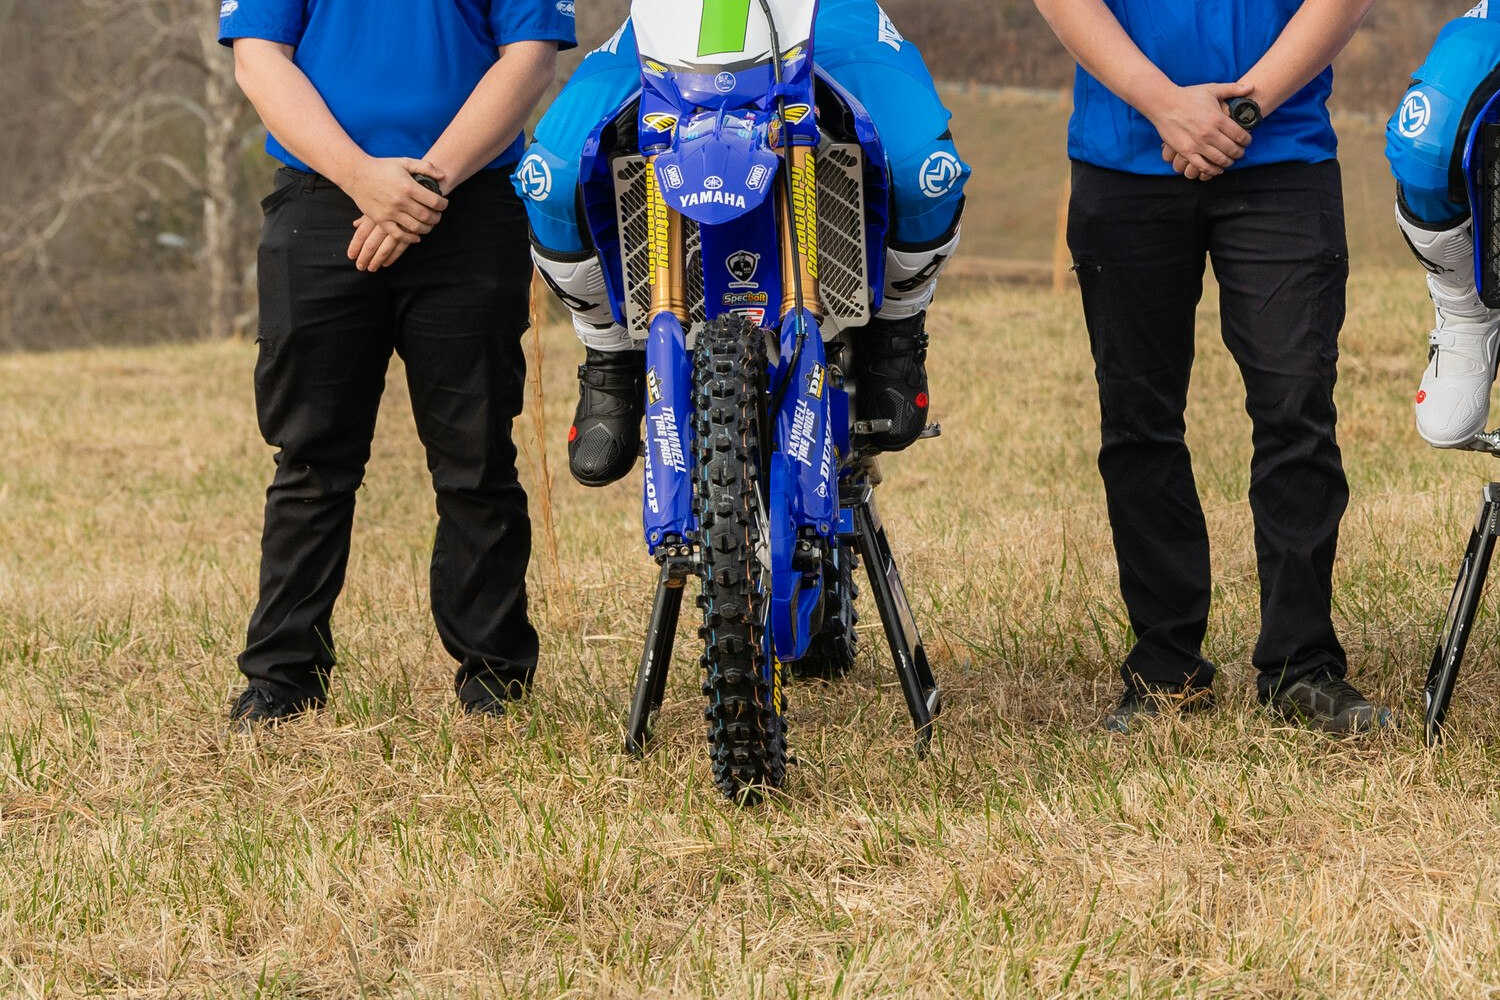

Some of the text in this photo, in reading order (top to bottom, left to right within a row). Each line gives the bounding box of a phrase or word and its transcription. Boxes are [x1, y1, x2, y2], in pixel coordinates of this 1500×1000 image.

[679, 190, 746, 209] YAMAHA
[749, 167, 764, 187] SHOEI
[654, 181, 669, 269] actory
[724, 292, 767, 304] Specbolt
[651, 414, 673, 467] TIRE PROS
[662, 406, 687, 473] TRAMMELL
[797, 408, 815, 467] TIRE PROS
